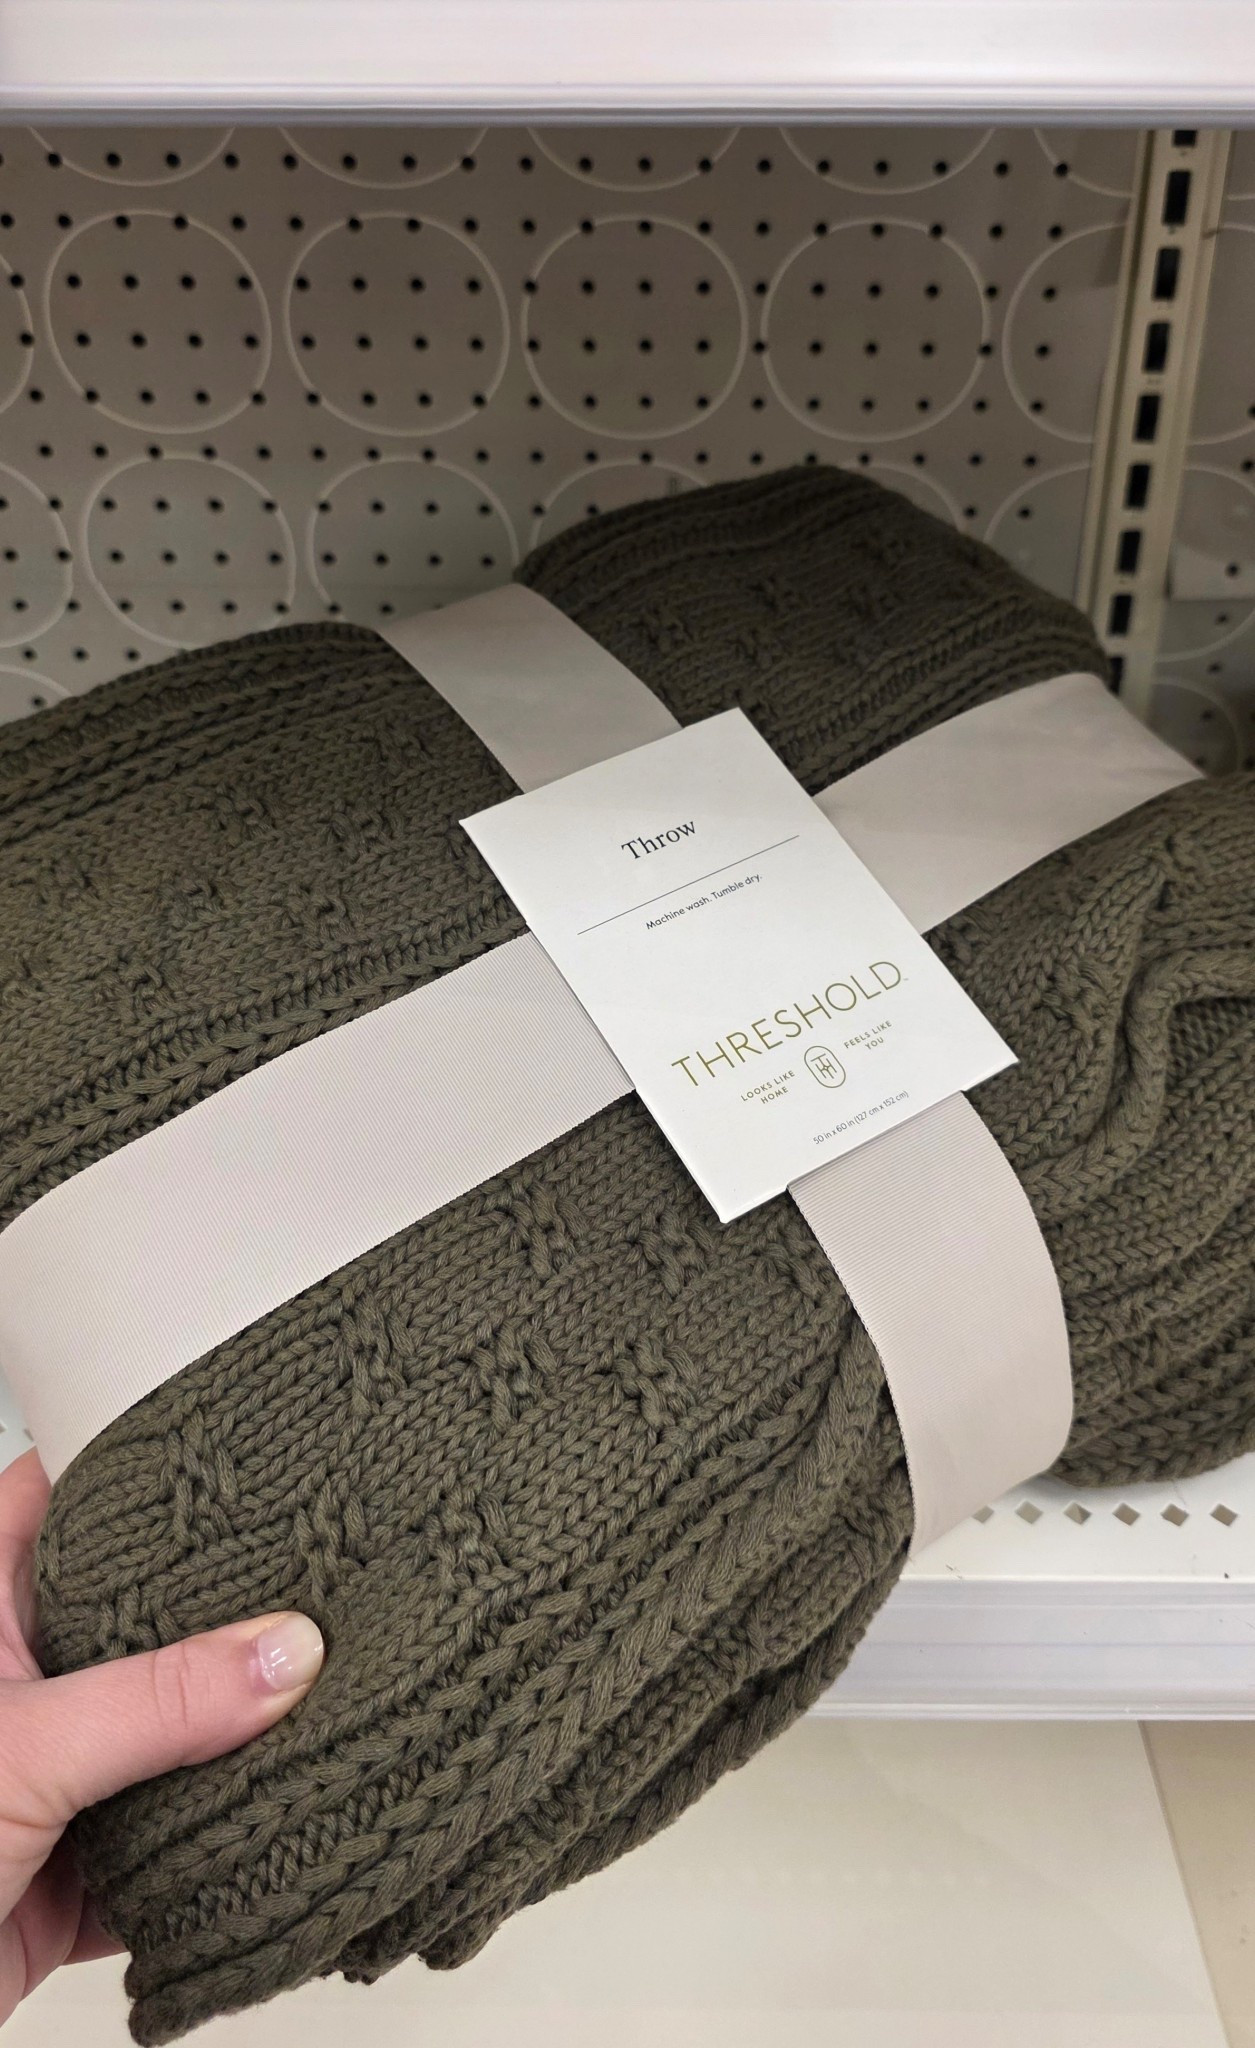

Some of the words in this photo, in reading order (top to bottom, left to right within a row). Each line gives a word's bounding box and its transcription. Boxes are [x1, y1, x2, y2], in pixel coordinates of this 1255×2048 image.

[621, 821, 696, 860] Throw
[646, 907, 686, 930] Machine
[685, 896, 712, 912] wash.
[712, 881, 745, 900] Tumble
[745, 873, 763, 886] dry.
[671, 961, 902, 1087] THRESHOLD
[843, 1032, 871, 1050] FEELS
[871, 1020, 893, 1035] LIKE
[864, 1036, 885, 1051] YOU
[740, 1082, 773, 1102] LOOKS
[773, 1070, 796, 1085] LIKE
[760, 1086, 789, 1105] HOME
[813, 1134, 825, 1145] 50
[835, 1122, 847, 1133] 60
[846, 1119, 855, 1128] in
[853, 1110, 868, 1125] (127
[868, 1106, 880, 1116] cm
[882, 1096, 896, 1108] 152
[895, 1090, 910, 1103] cm)
